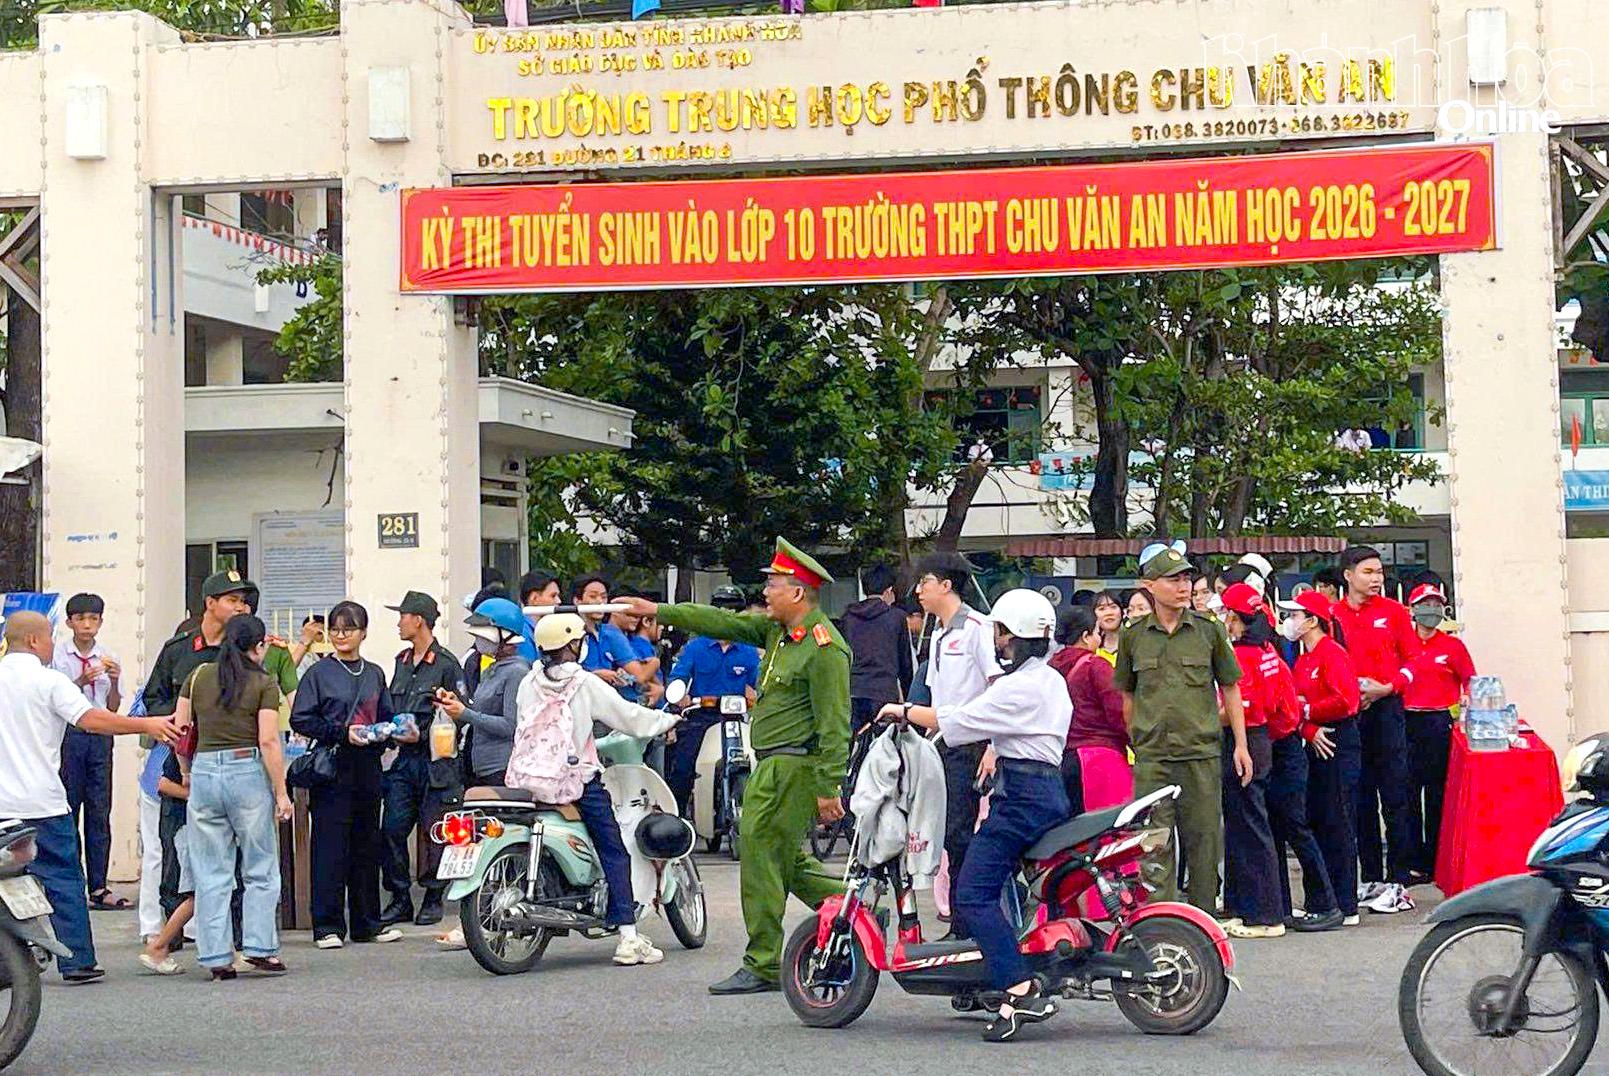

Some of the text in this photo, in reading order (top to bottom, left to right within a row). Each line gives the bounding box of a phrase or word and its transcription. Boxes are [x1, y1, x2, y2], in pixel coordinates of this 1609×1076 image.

[518, 52, 545, 76] SỞ
[550, 53, 593, 75] GIÁO
[641, 50, 665, 71] VÀ
[715, 47, 753, 70] TẠO
[487, 82, 651, 140] TRƯỜNG
[661, 86, 797, 133] TRUNG
[807, 80, 892, 136] HỌC
[998, 62, 1139, 119] THÔNG
[1151, 64, 1233, 112] CHU
[1246, 52, 1327, 106] VĂN
[1338, 54, 1396, 104] AN
[623, 145, 645, 163] 21
[421, 205, 453, 271] KỲ
[460, 215, 502, 269] THI
[508, 190, 591, 268] TUYỂN
[598, 211, 661, 267] SINH
[667, 199, 717, 264] VÀO
[726, 196, 776, 263] LỚP
[783, 207, 816, 261] 10
[821, 190, 927, 261] TRƯỜNG
[933, 200, 999, 256] THPT
[1005, 197, 1059, 254] CHU
[1066, 184, 1121, 251] VĂN
[1128, 192, 1167, 249] AN
[1174, 179, 1238, 247] NĂM
[1246, 186, 1303, 256] HỌC
[1309, 182, 1376, 241] 2026
[1402, 178, 1471, 236] 2027
[382, 516, 416, 536] 281
